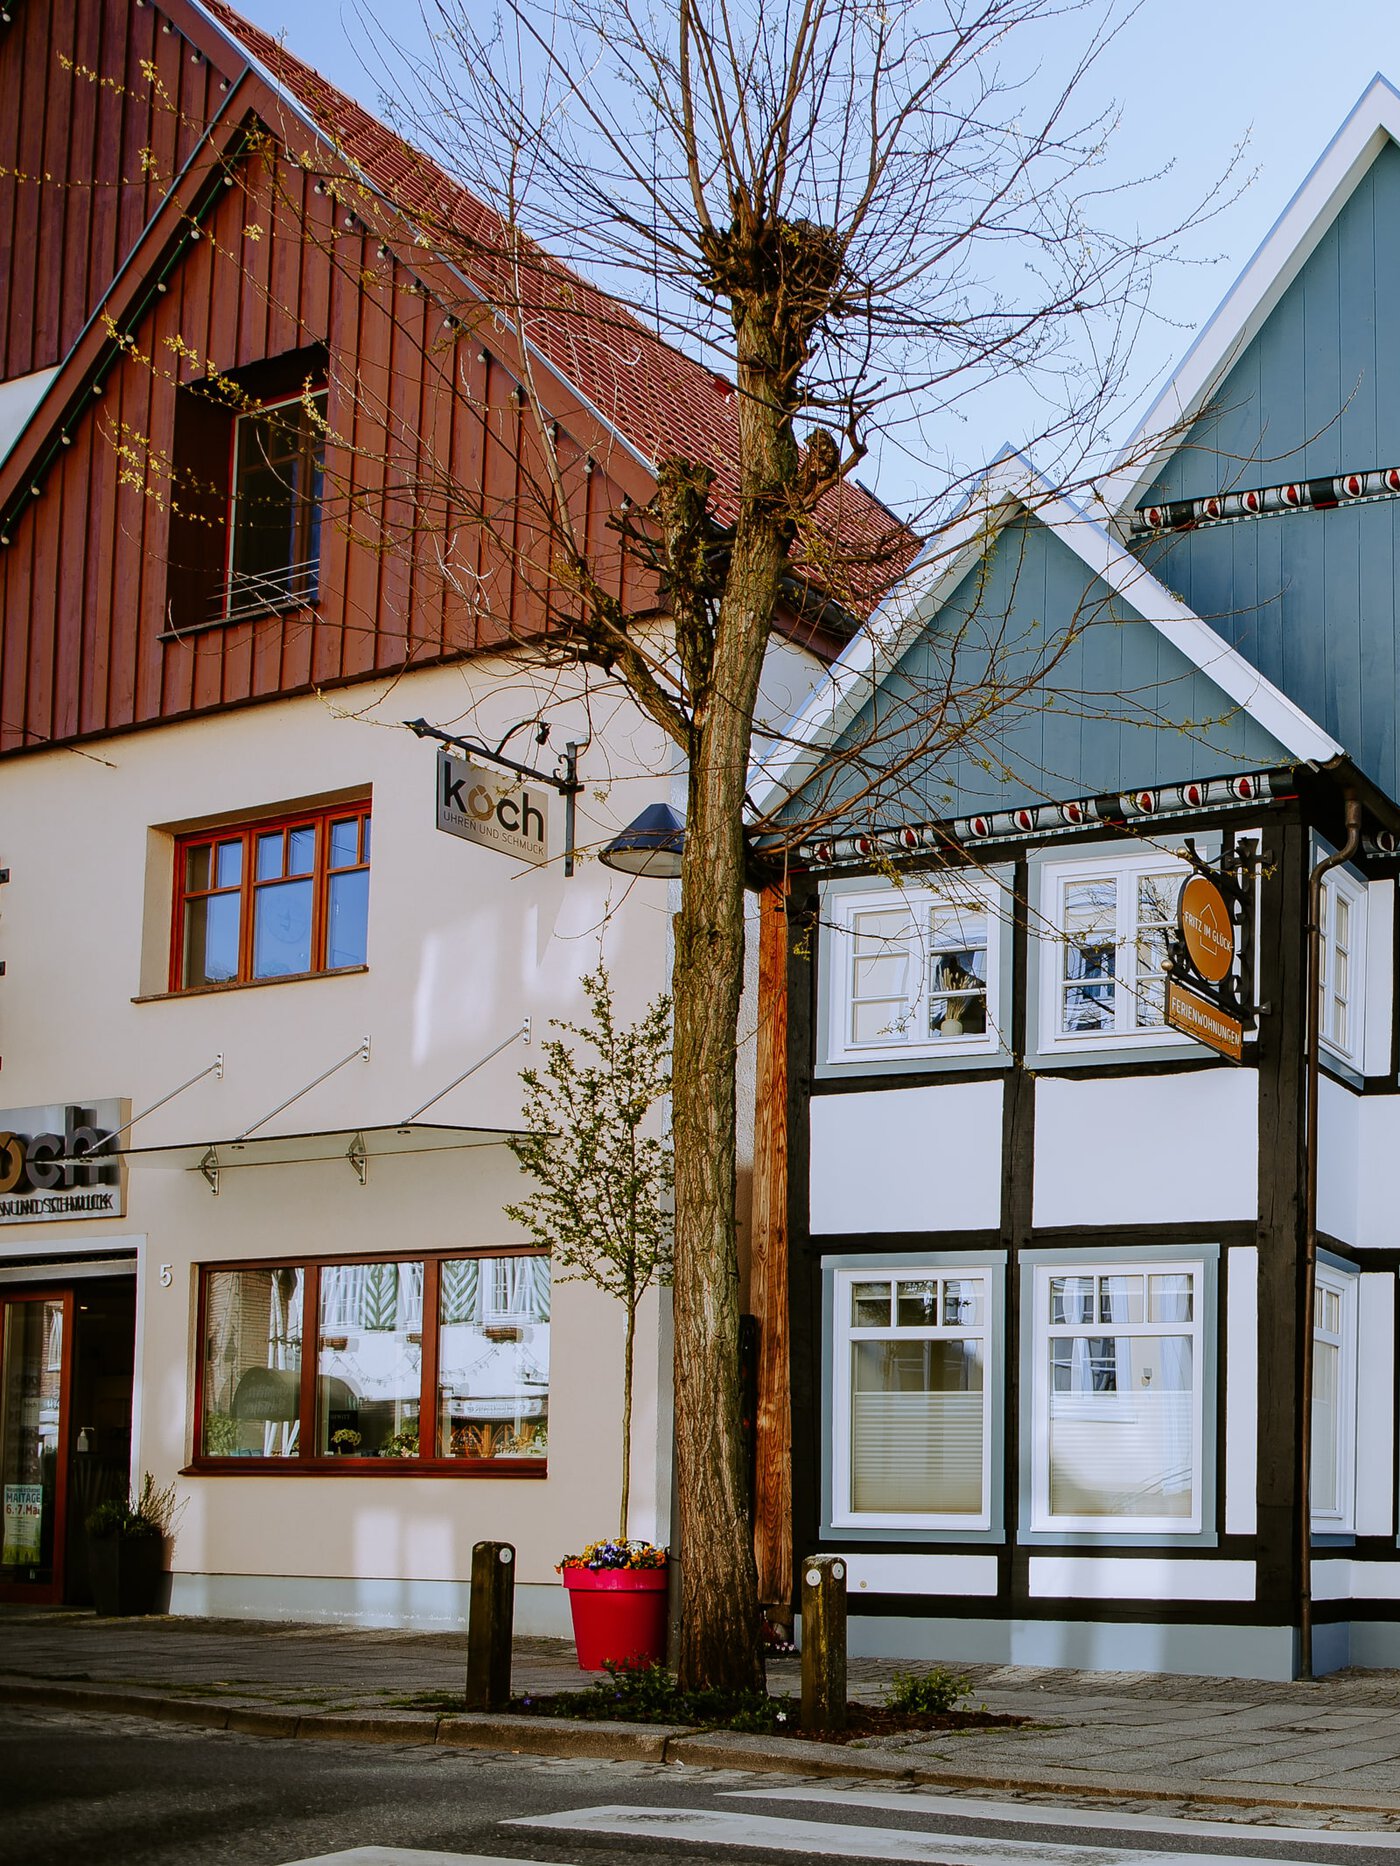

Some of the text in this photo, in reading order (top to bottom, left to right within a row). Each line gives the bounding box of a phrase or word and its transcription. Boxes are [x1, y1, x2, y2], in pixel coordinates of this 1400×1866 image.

[443, 810, 544, 856] UHREN UND SCHMUCK
[1184, 911, 1231, 952] FRITZ IM GLÜCK
[1171, 996, 1240, 1046] FERIENWOHNUNGEN
[159, 1263, 173, 1288] 5
[6, 1492, 41, 1504] MAITAGE
